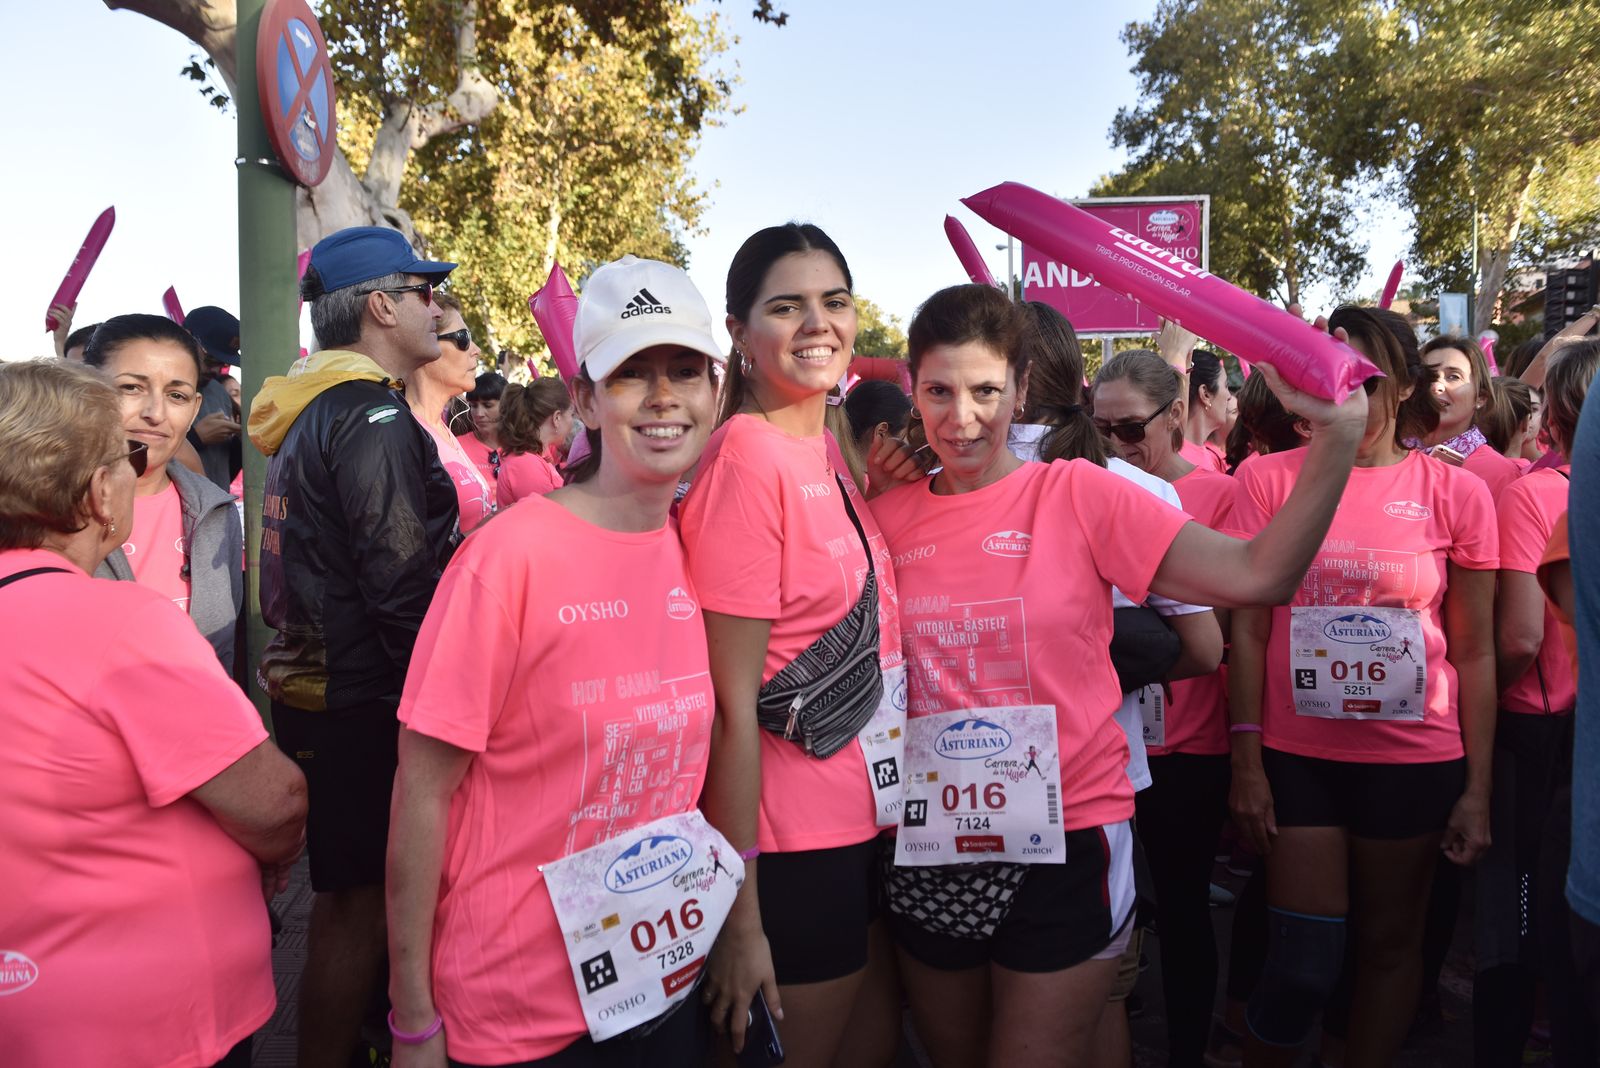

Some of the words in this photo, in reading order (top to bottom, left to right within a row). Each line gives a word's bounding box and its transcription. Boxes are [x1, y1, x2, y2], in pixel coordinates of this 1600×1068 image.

[1024, 261, 1101, 288] AND
[1095, 244, 1118, 261] TRIPLE
[1119, 255, 1165, 285] PROTECCIÓN
[1163, 279, 1191, 298] SOLAR
[621, 304, 672, 319] adidas
[986, 538, 1030, 551] ASTURIA
[1321, 540, 1355, 552] ANAN
[1324, 559, 1359, 569] VITORIA
[1367, 561, 1404, 573] GASTEIZ
[1342, 569, 1379, 580] MADRID
[558, 599, 629, 624] OYSHO
[916, 621, 955, 634] VITORIA
[963, 617, 1007, 631] GASTEIZ
[1328, 625, 1387, 637] ASTURIANA
[938, 634, 979, 646] MADRID
[1369, 644, 1396, 653] Carrera
[1385, 653, 1403, 663] Mujer
[1330, 660, 1386, 681] 016
[571, 679, 608, 706] HOY
[1344, 685, 1372, 696] 5251
[635, 701, 669, 723] VITORIA
[673, 693, 707, 713] GASTEIZ
[1300, 700, 1330, 708] OYSHO
[657, 714, 688, 736] MADRID
[940, 737, 1005, 752] ASTURIANA
[984, 758, 1018, 769] Carrera
[1004, 769, 1029, 783] Mujer
[942, 783, 1007, 812] 016
[955, 816, 991, 830] 7124
[905, 841, 940, 853] OYSHO
[1022, 847, 1052, 855] ZURICH
[614, 847, 688, 889] ASTURIANA
[673, 867, 704, 888] Carrera
[695, 873, 717, 894] Mujer
[630, 898, 704, 953] 016
[657, 941, 694, 969] 7328
[598, 992, 646, 1021] OYSHO
